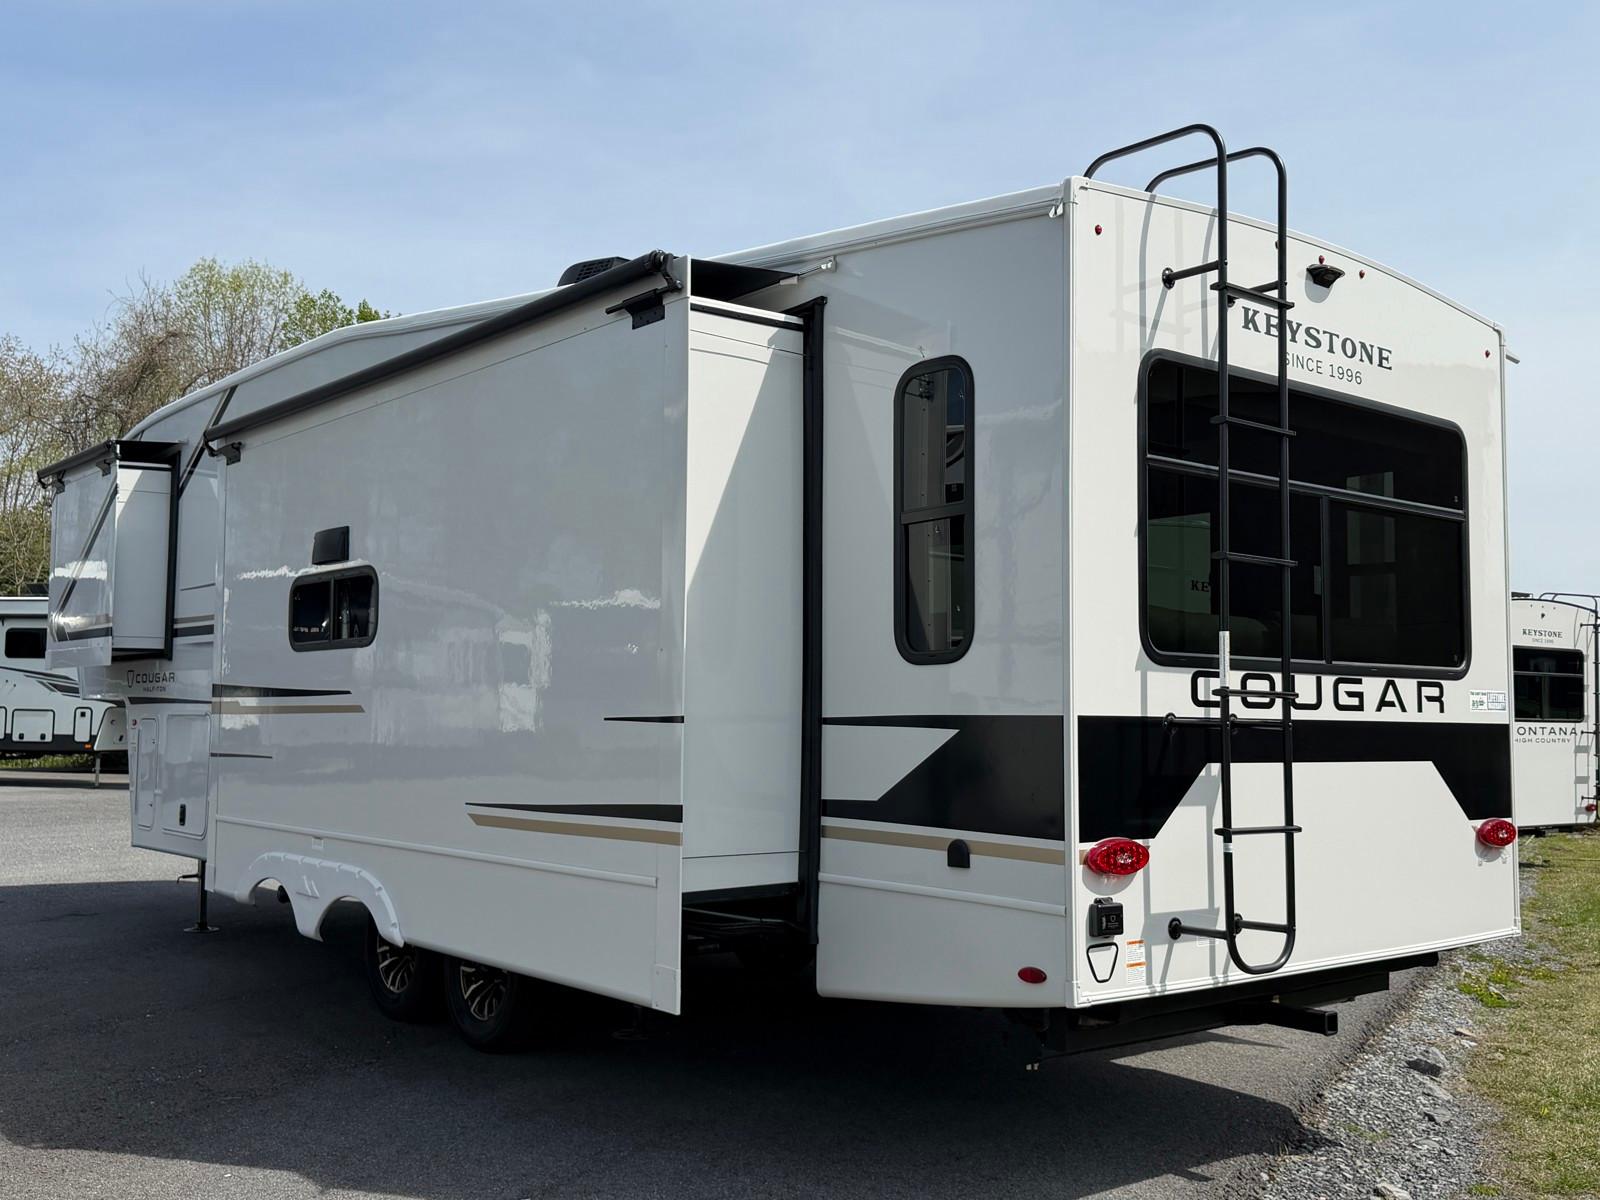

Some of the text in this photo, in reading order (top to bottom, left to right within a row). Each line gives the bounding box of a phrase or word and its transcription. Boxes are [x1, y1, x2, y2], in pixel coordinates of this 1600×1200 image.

[1241, 305, 1393, 371] KEYSTONE
[1328, 363, 1363, 385] 1996
[1522, 628, 1563, 639] KEYSTONE
[135, 671, 176, 684] COUGAR
[1190, 669, 1446, 714] COUGAR
[1516, 726, 1578, 736] ONTANA
